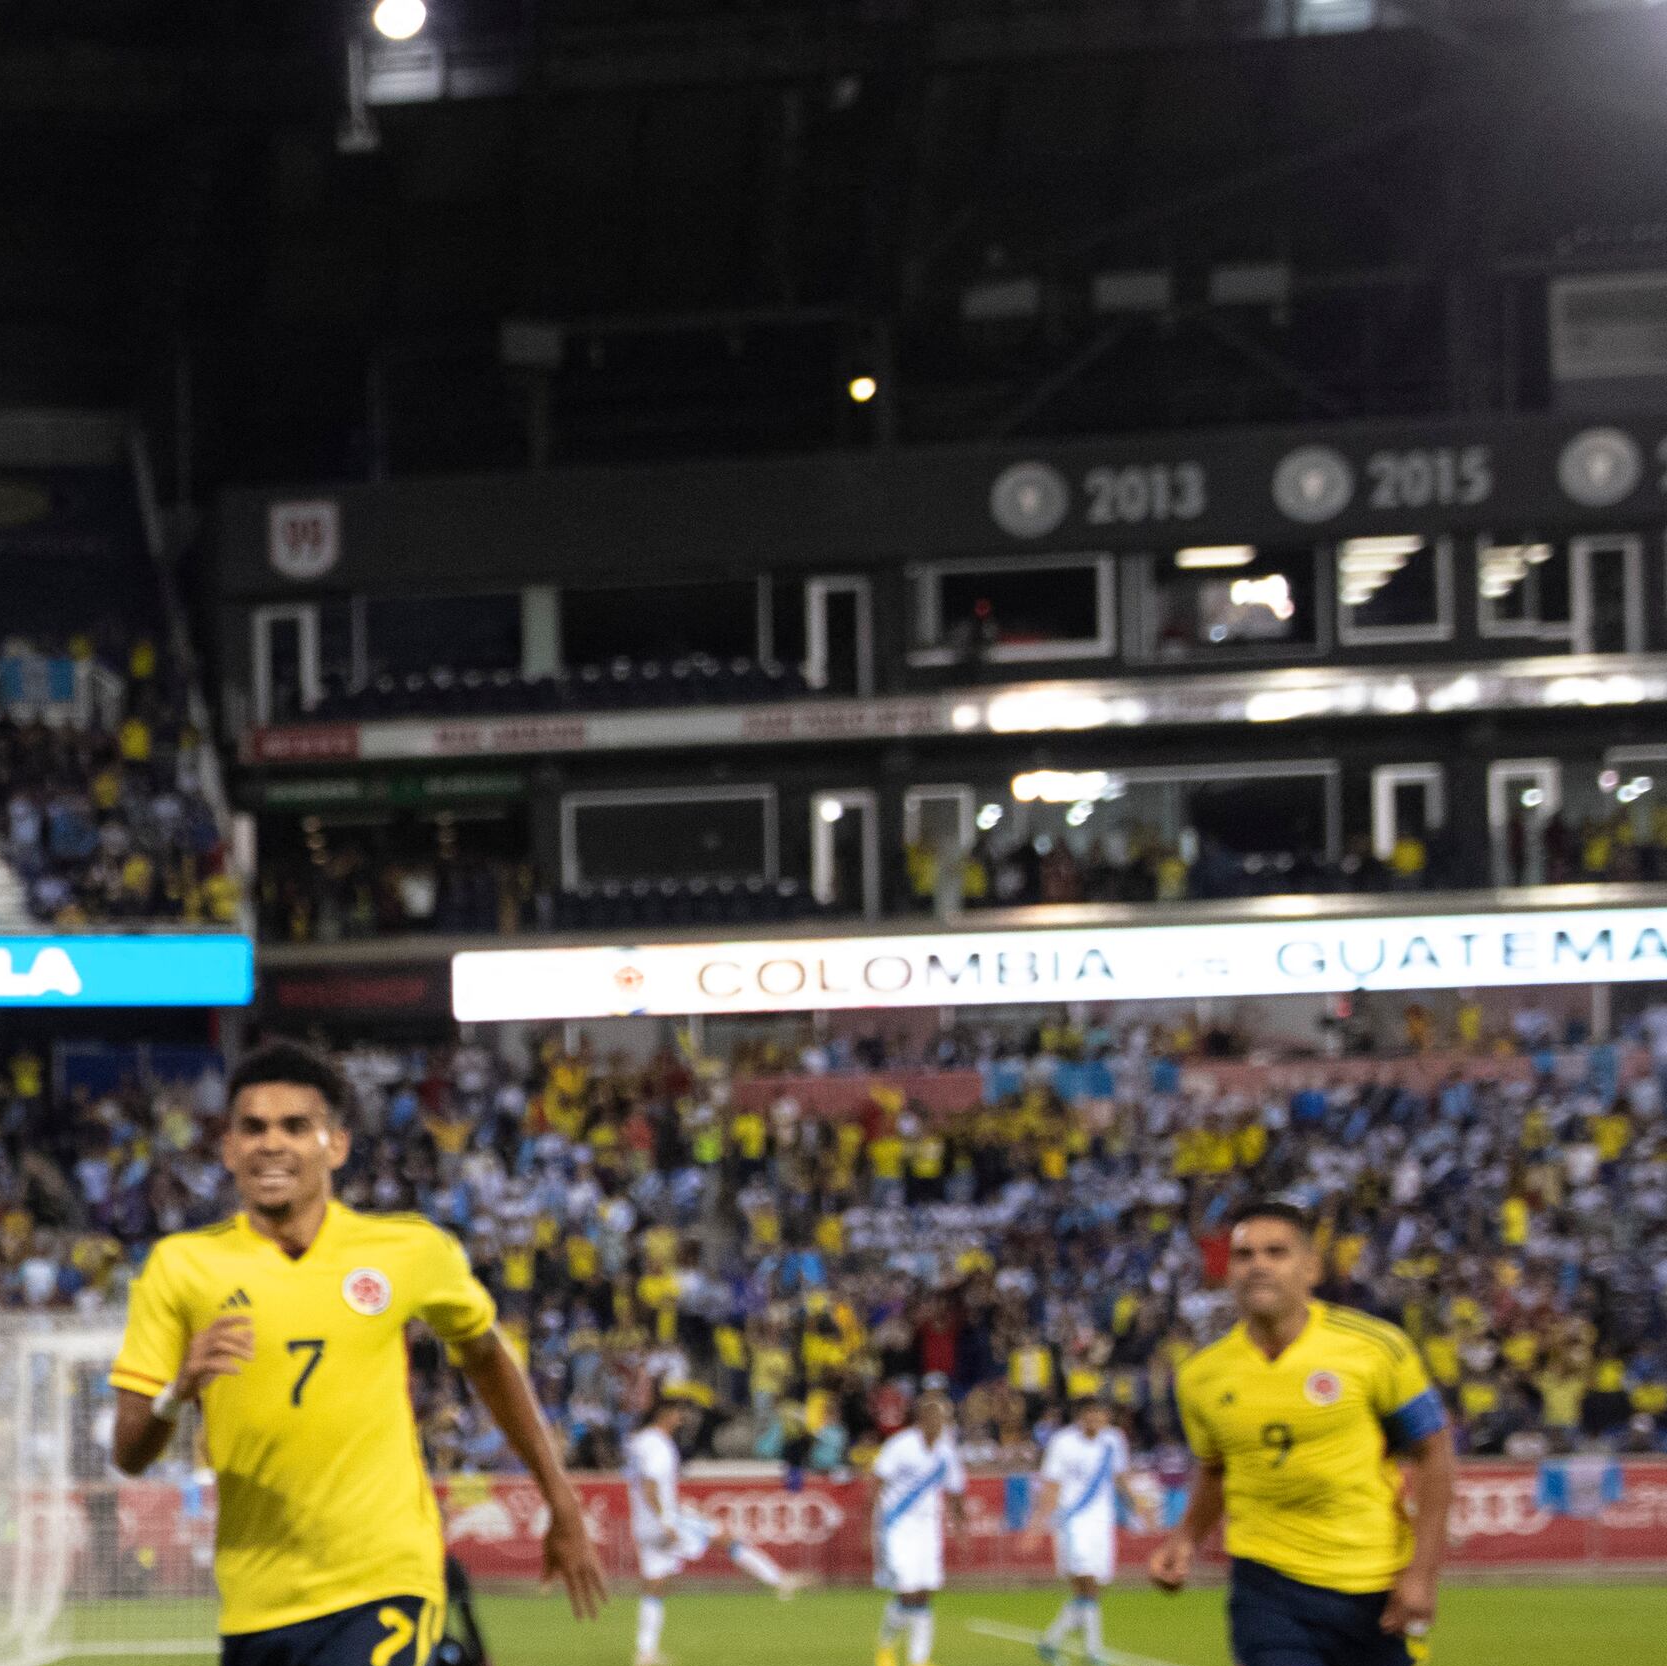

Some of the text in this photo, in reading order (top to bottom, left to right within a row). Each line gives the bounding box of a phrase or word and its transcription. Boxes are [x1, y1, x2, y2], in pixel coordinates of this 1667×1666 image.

[1082, 461, 1207, 526] 2013
[1365, 445, 1492, 511] 2015
[696, 948, 1115, 998] COLOMBIA
[286, 1339, 326, 1407] 7
[1261, 1423, 1293, 1468] 9
